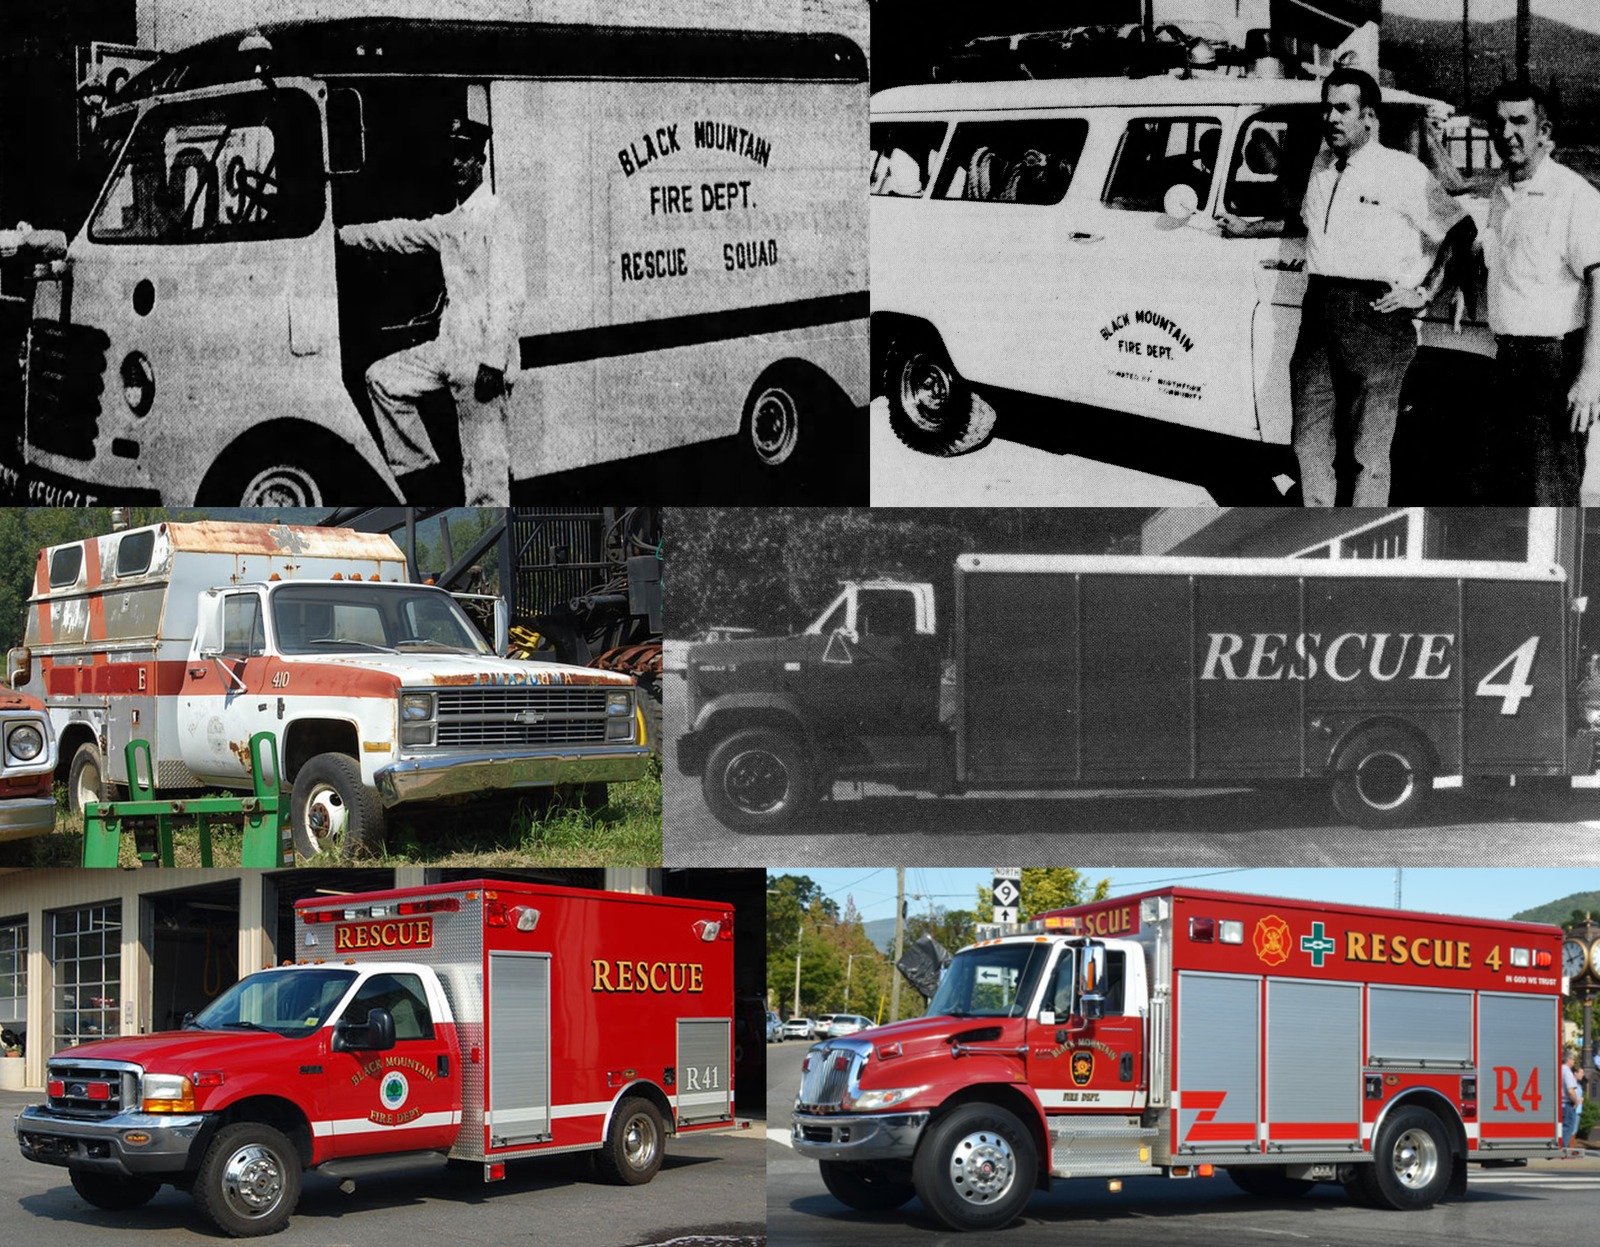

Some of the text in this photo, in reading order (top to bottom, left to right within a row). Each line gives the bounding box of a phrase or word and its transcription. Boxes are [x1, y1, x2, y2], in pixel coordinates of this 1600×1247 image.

[618, 121, 772, 178] BLACK MOUNTAIN
[650, 181, 757, 215] FIRE DEPT.
[621, 239, 778, 282] RESCUE SQUAD
[1100, 310, 1194, 352] BLACK MOUNTAIN
[1118, 340, 1174, 360] FIRE DEPT.
[138, 667, 147, 692] E
[272, 671, 291, 689] 410
[1199, 632, 1541, 715] RESCUE 4
[1001, 886, 1012, 901] 9
[336, 921, 431, 950] RESCUE
[1076, 907, 1132, 937] SCUE
[1344, 931, 1503, 973] RESCUE 4
[592, 959, 705, 994] RESCUE
[1505, 975, 1557, 986] IN GOD WE TRUST
[1051, 1039, 1075, 1058] BLACK
[1077, 1038, 1118, 1061] MOUNTAIN
[351, 1056, 437, 1087] BLACK MOUNTAIN
[1062, 1092, 1079, 1102] FIRE
[1492, 1065, 1543, 1113] R4
[370, 1106, 424, 1125] FIRE DEPT.
